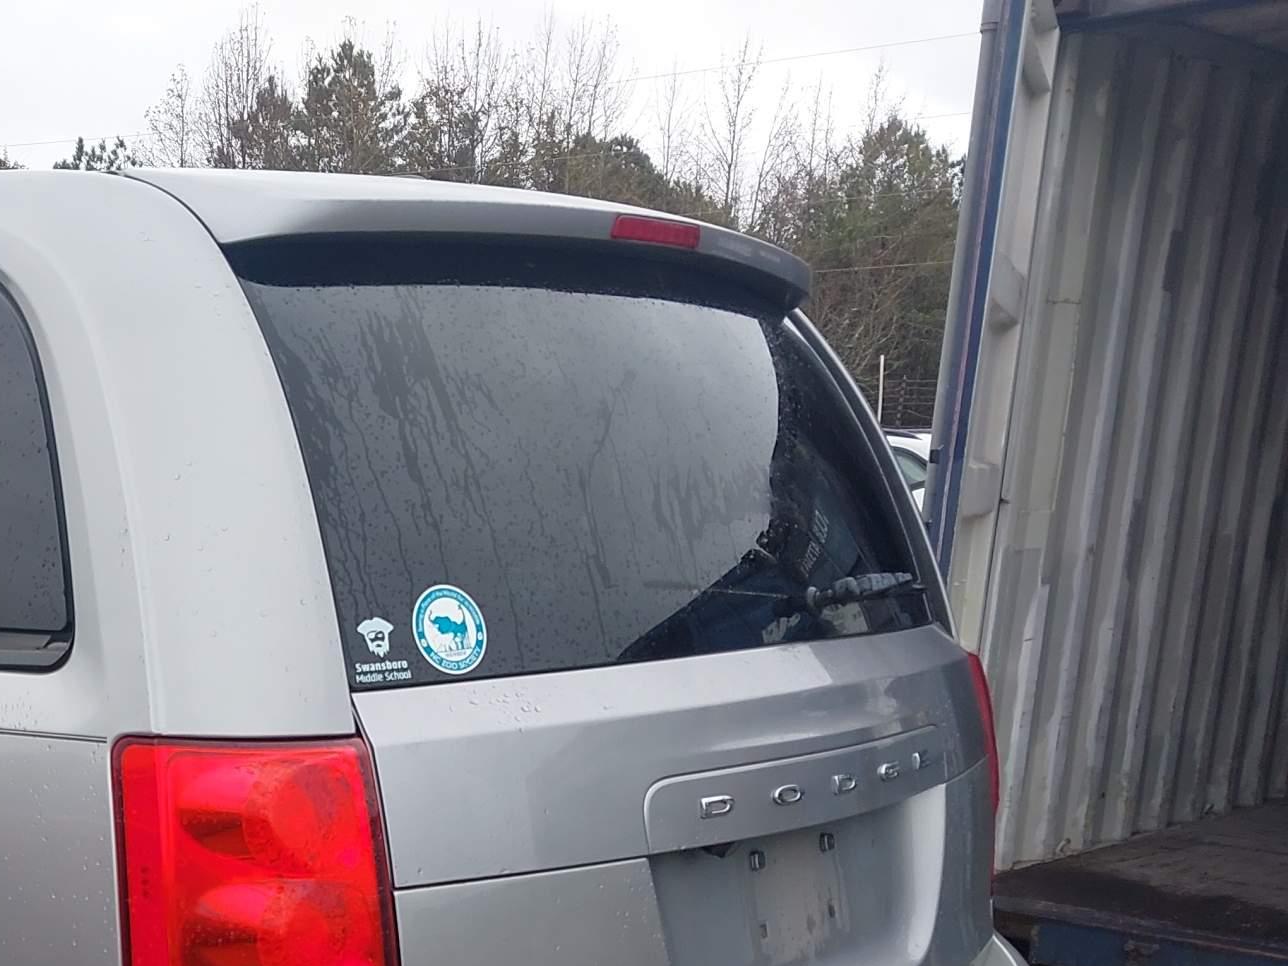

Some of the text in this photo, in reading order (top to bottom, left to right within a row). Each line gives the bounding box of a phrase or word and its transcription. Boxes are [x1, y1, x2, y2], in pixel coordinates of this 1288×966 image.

[355, 660, 408, 673] Swansboro
[441, 659, 459, 670] ZOO
[458, 645, 481, 670] SOCIETY
[355, 669, 412, 684] Middle School
[700, 751, 930, 820] DODGE
